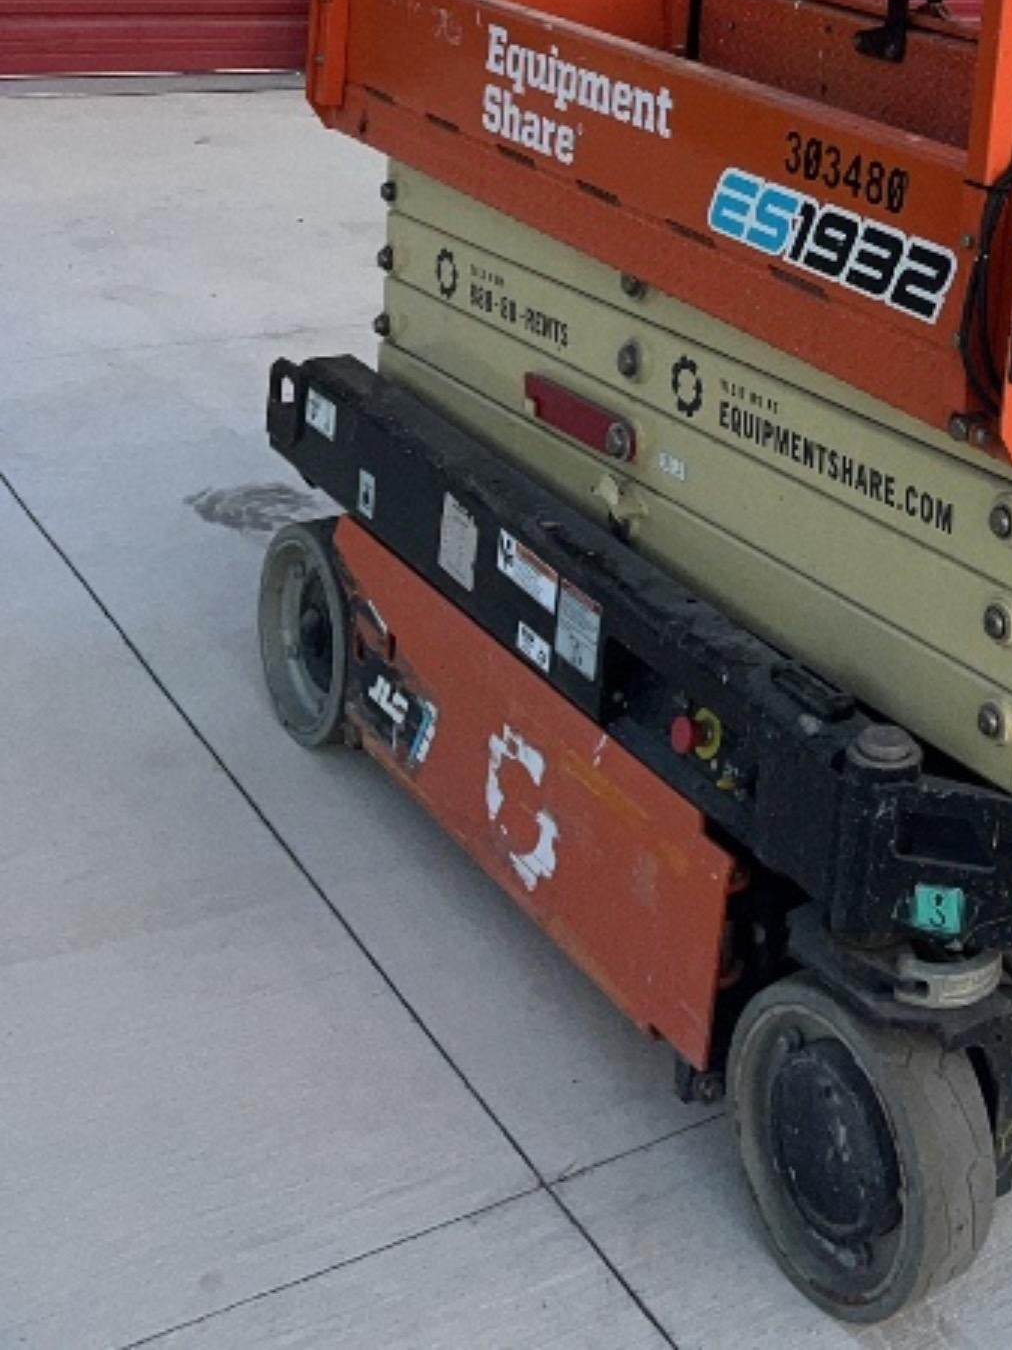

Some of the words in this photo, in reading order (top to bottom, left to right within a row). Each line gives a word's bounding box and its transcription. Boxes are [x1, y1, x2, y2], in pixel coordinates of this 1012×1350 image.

[482, 83, 577, 165] Share
[485, 23, 673, 138] Equipment
[785, 131, 909, 213] 303480
[707, 166, 958, 325] ES1932
[719, 401, 954, 535] EQUIPMENTSHARE.COM
